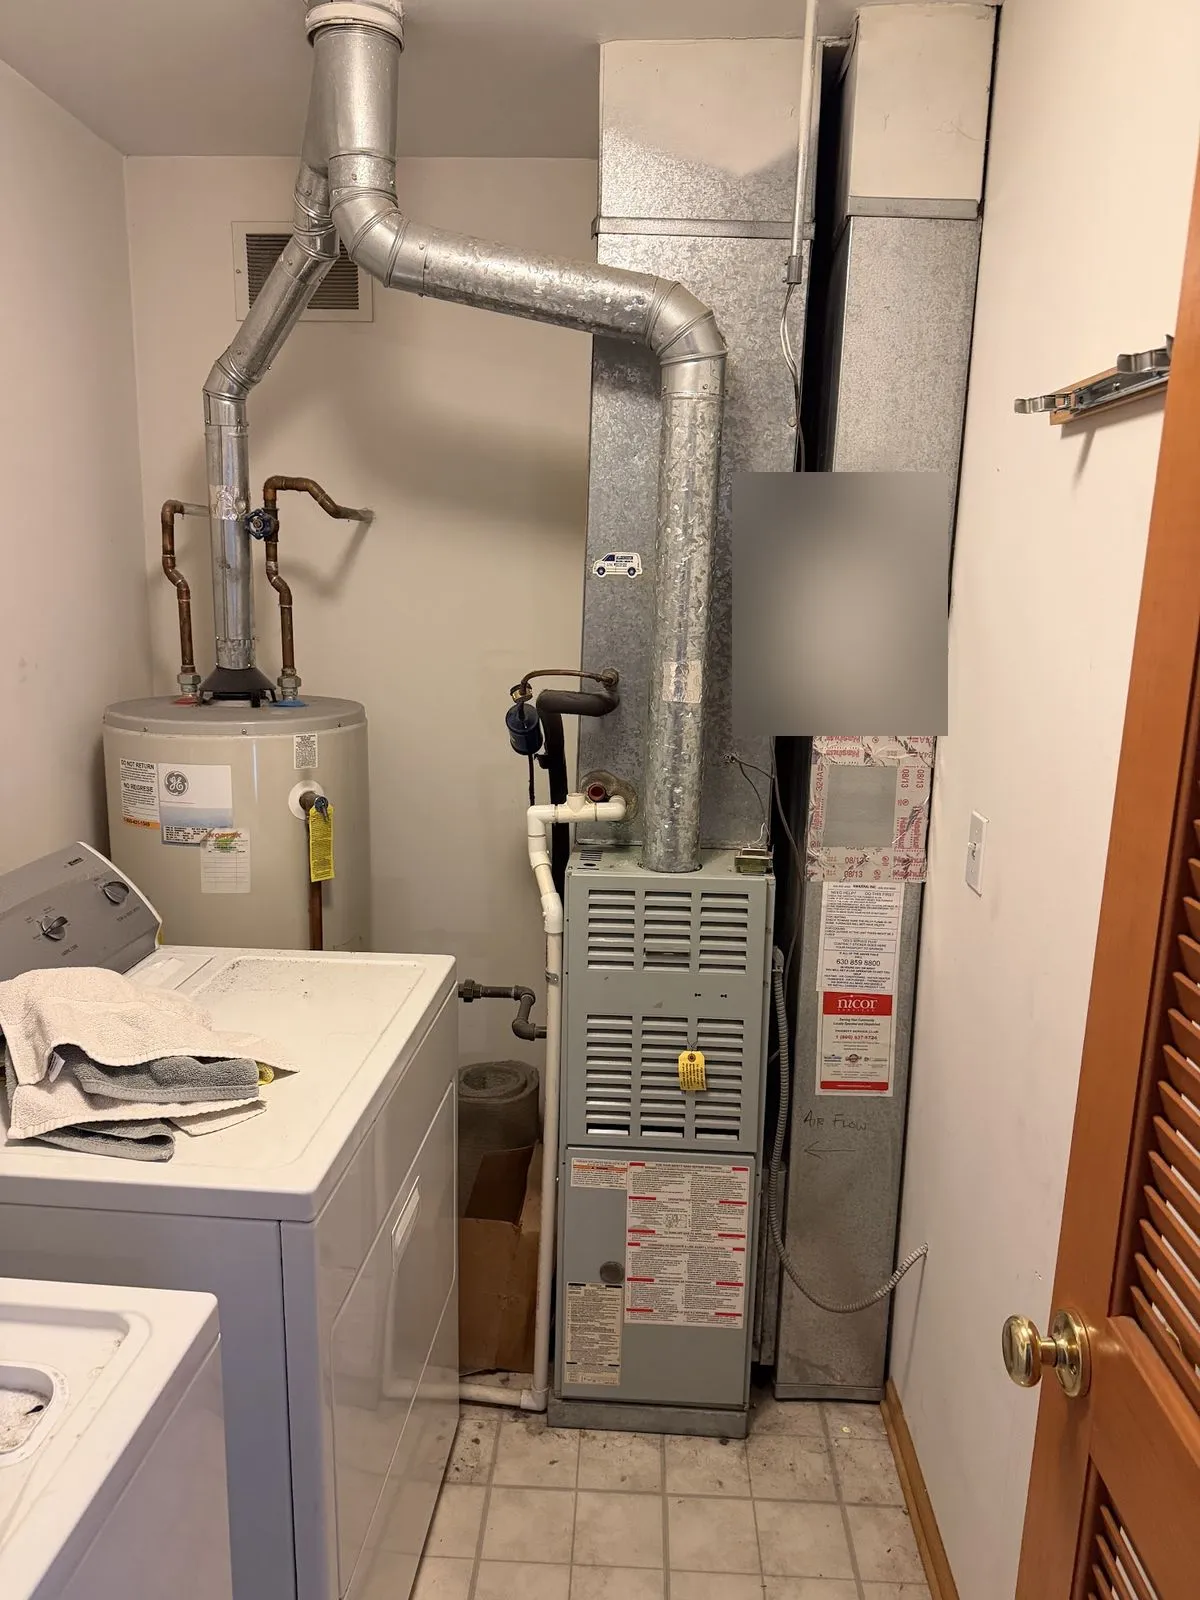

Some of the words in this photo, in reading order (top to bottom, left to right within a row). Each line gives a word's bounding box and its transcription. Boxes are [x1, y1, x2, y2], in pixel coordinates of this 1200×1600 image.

[135, 761, 155, 770] RETURN
[901, 769, 910, 789] 08/13
[916, 769, 925, 789] 08/13
[844, 870, 863, 878] 08/13
[837, 996, 878, 1010] nicor
[803, 1109, 824, 1129] AIR
[833, 1113, 867, 1131] FLOW
